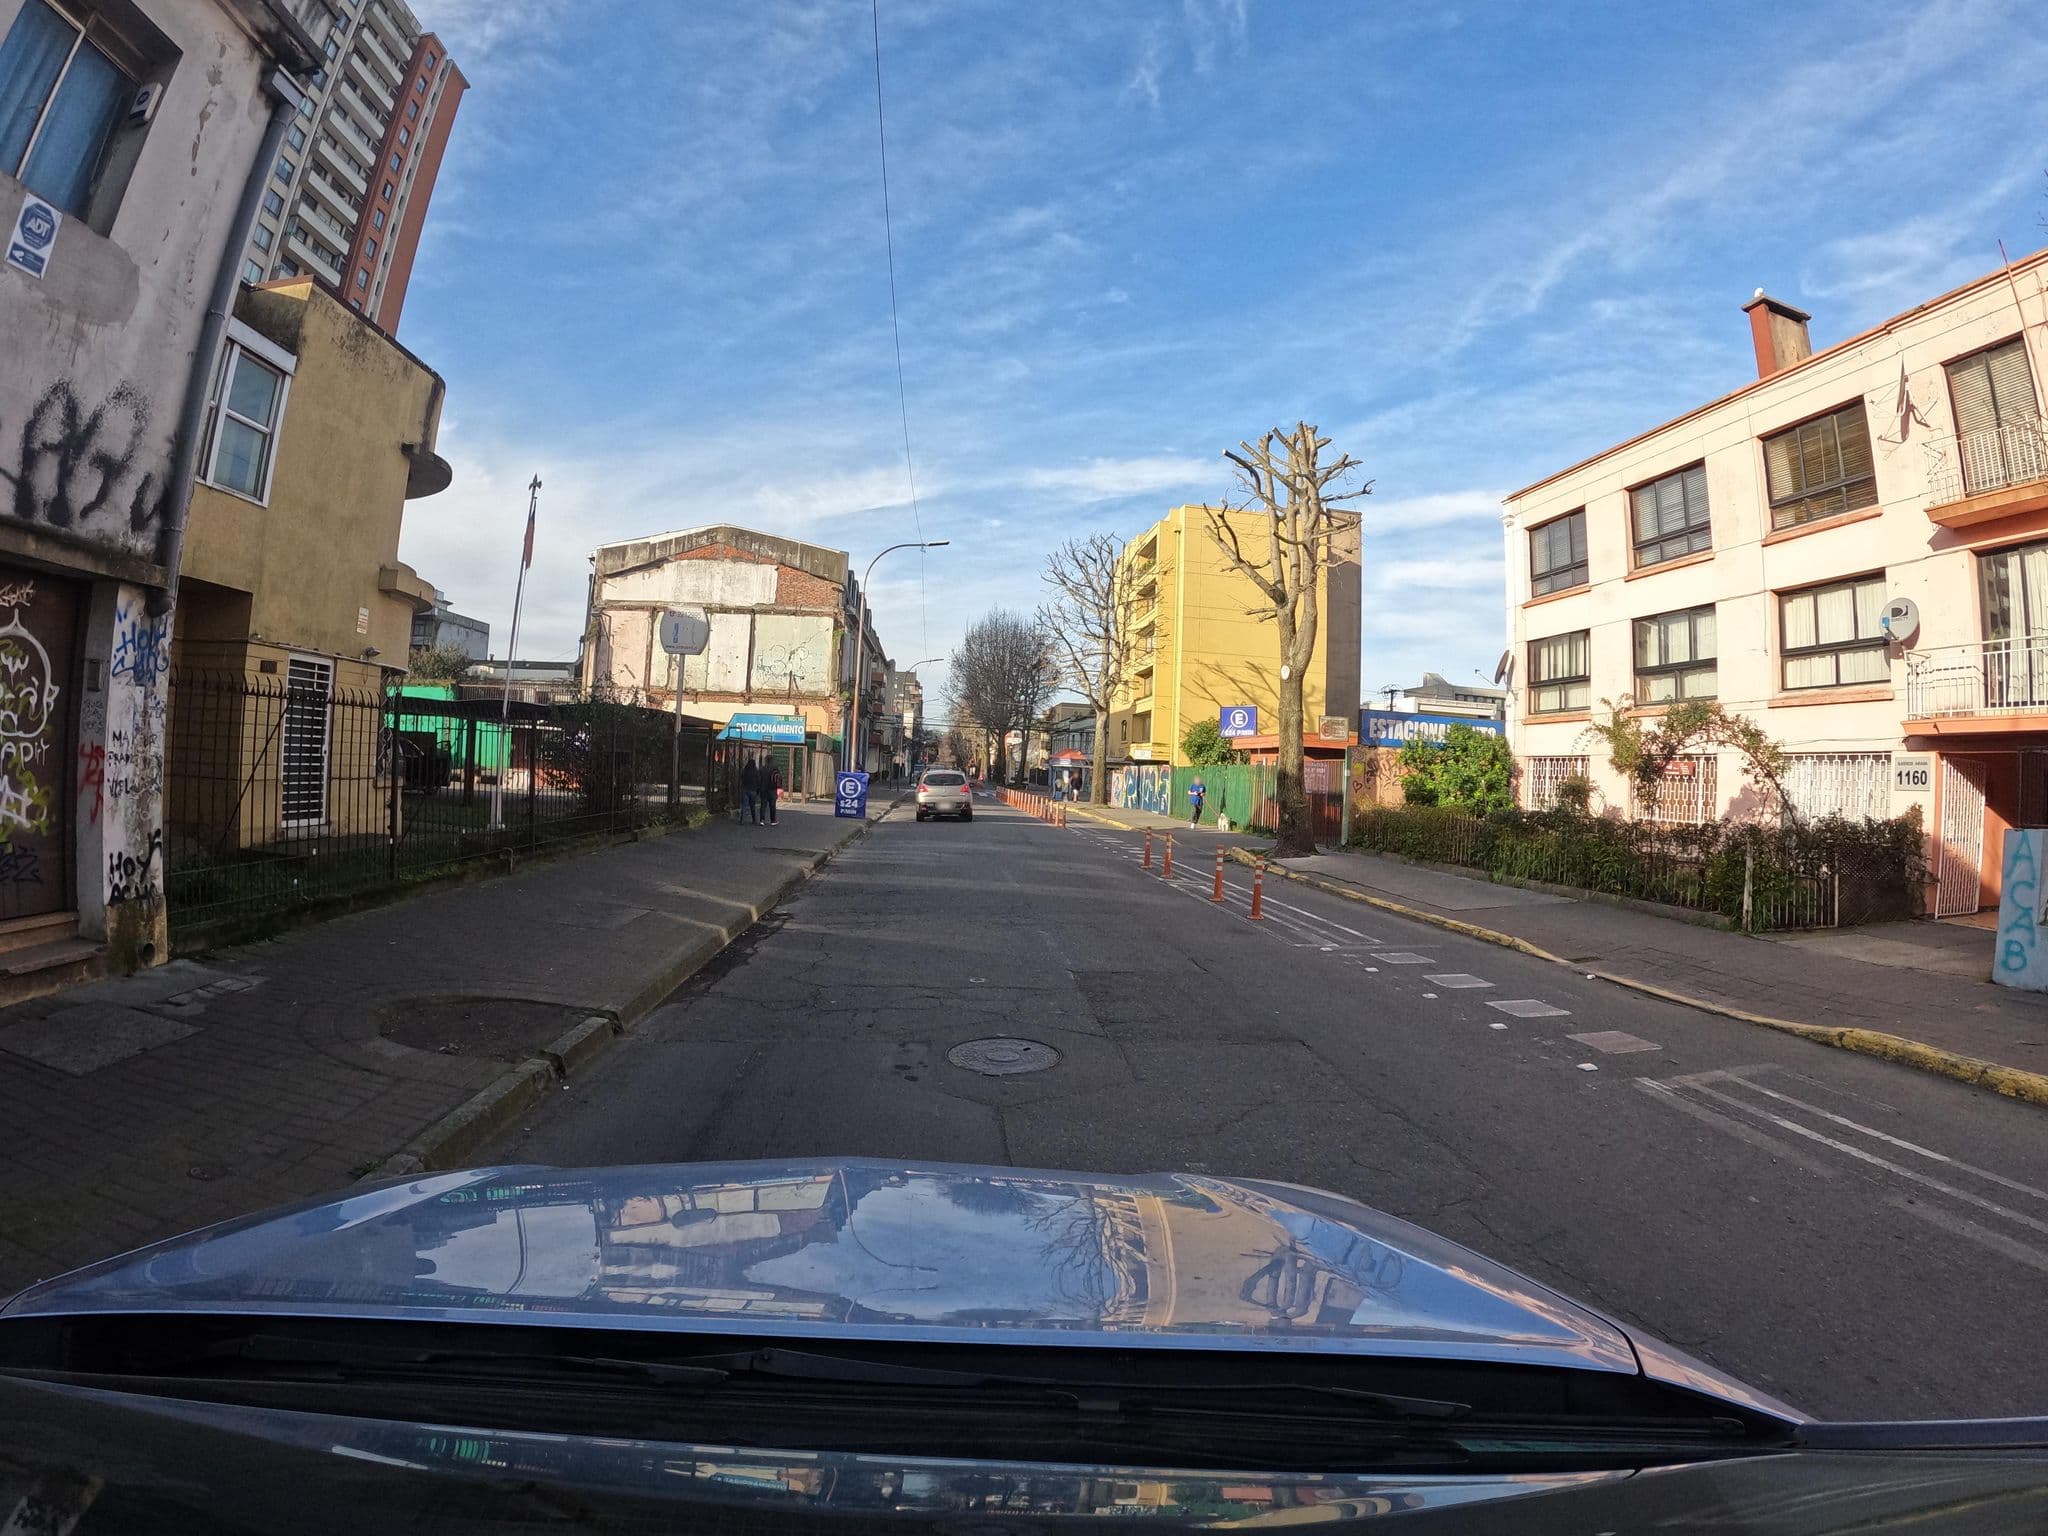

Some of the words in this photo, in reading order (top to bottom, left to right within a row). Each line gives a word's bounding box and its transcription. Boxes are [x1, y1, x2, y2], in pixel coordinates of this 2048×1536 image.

[26, 217, 51, 237] ADT
[736, 722, 804, 735] ESTACIONAMIENTO
[1897, 770, 1928, 786] 1160
